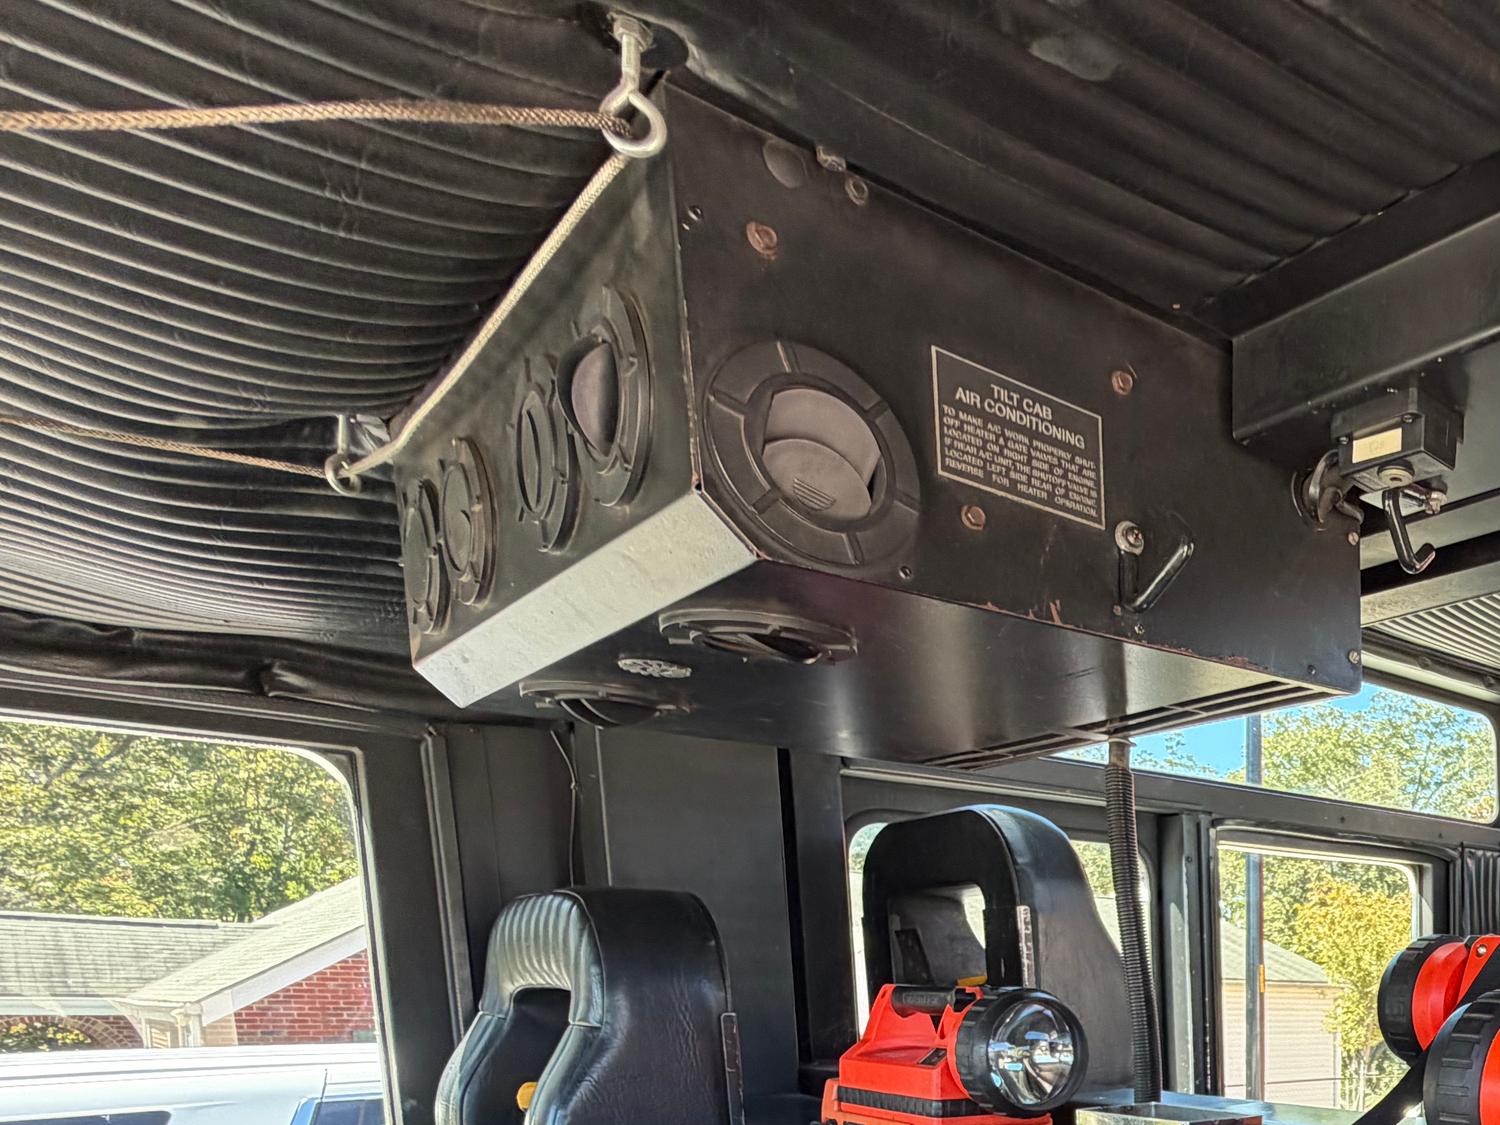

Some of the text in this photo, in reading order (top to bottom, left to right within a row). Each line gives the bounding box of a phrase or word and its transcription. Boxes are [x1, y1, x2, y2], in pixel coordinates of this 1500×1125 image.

[954, 385, 1085, 450] AIR CONDITIONING
[990, 384, 1051, 421] TILT CAB
[943, 405, 955, 417] TO
[959, 411, 983, 428] MAKE
[986, 422, 1001, 434] A/C
[1004, 429, 1029, 445] WORK
[1032, 439, 1071, 461] PROPERLY
[943, 416, 960, 429] OFF
[963, 423, 995, 442] HEATER
[1030, 449, 1057, 465] VALVES
[1061, 460, 1078, 473] THAT
[1082, 468, 1096, 479] ARE
[944, 426, 982, 447] LOCATED
[986, 442, 999, 453] ON
[1003, 449, 1027, 464] RIGHT
[1031, 459, 1049, 471] SIDE
[1053, 467, 1063, 476] OF
[944, 437, 952, 447] IF
[953, 440, 976, 456] REAR
[978, 449, 992, 461] A/C
[1016, 463, 1030, 475] THE
[1032, 469, 1065, 487] SHUTOFF
[1067, 481, 1088, 495] VALVE
[1090, 490, 1097, 499] IS
[945, 448, 983, 468] LOCATED
[987, 462, 1005, 476] LEFT
[1009, 471, 1028, 484] SIDE
[1031, 478, 1051, 492] REAR
[1054, 486, 1063, 496] OF
[945, 458, 983, 478] REVERSE
[992, 474, 1008, 487] FOR
[1017, 483, 1047, 500] HEATER
